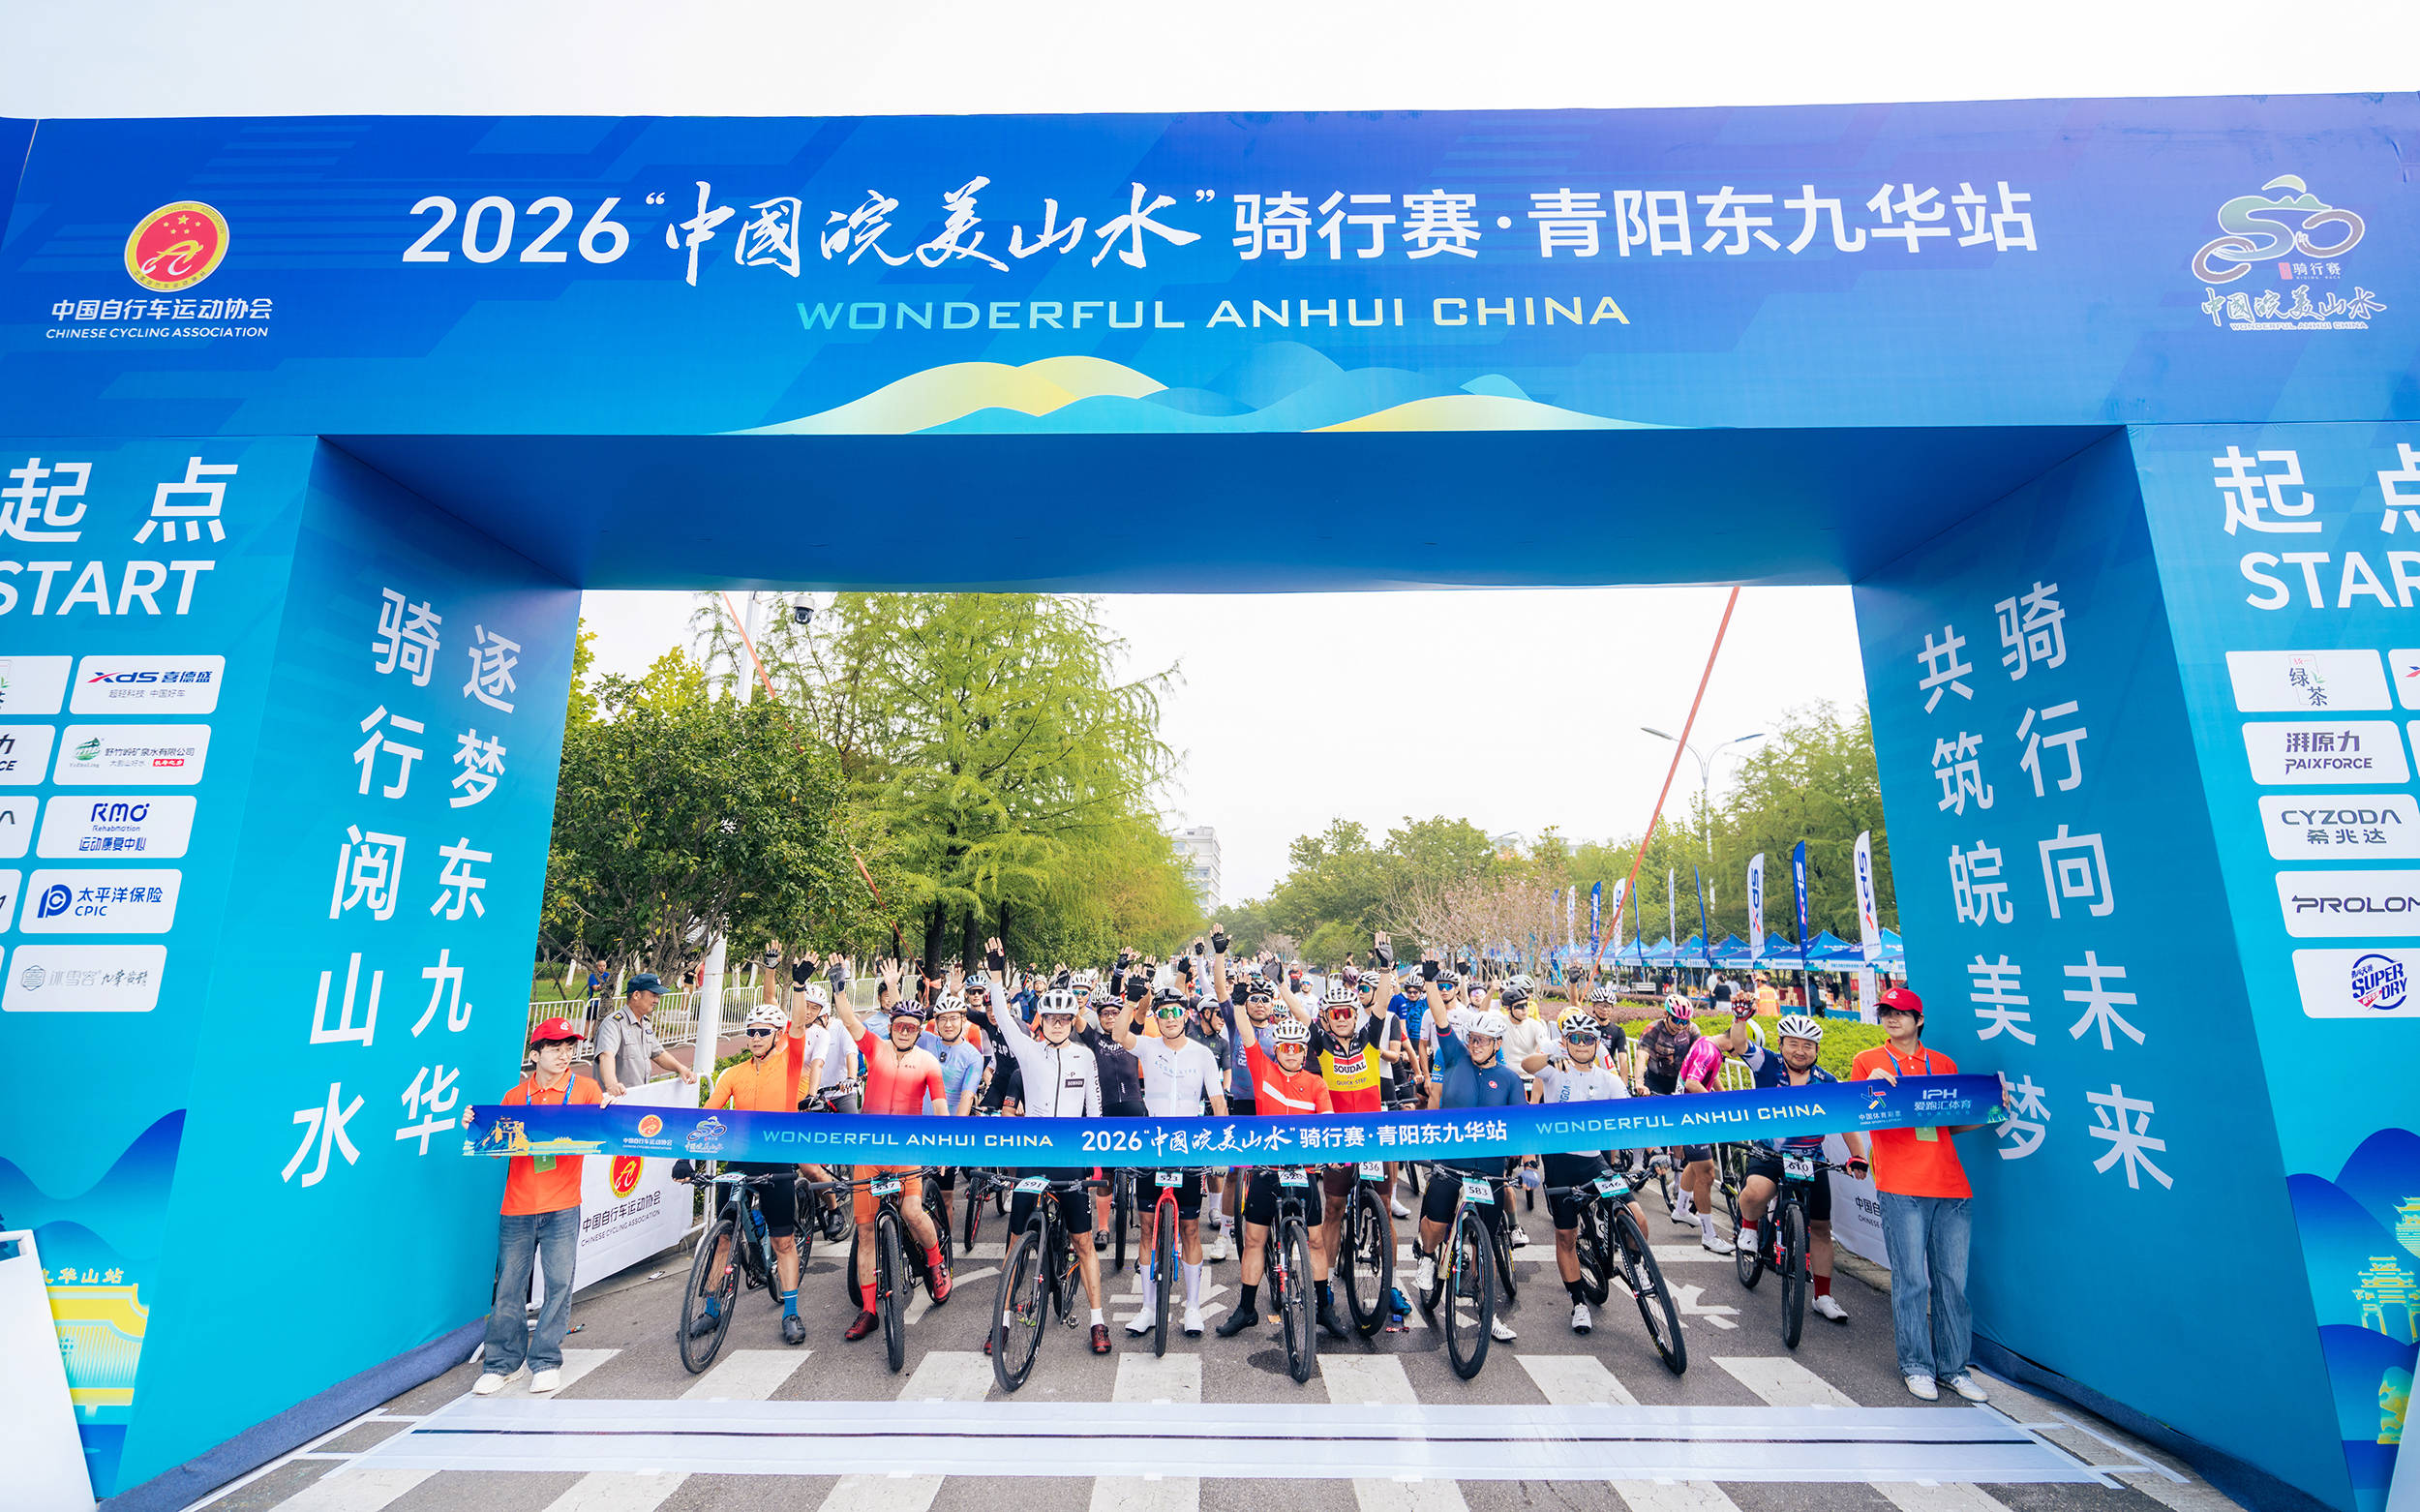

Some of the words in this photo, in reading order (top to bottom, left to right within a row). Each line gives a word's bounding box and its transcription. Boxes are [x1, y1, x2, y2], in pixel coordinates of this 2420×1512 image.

[2292, 262, 2341, 275] 骑行赛
[51, 297, 273, 321] 中国自行车运动协会
[797, 300, 1185, 330] WONDERFUL
[1206, 297, 1403, 327] ANHUI
[1433, 296, 1631, 326] CHINA
[45, 328, 106, 339] CHINESE
[109, 327, 169, 338] CYCLING
[171, 326, 268, 338] ASSOCIATION
[2230, 321, 2296, 331] WONDERFUL
[2298, 321, 2332, 330] ANHUI
[161, 671, 212, 683] 喜德盛
[2289, 667, 2327, 706] 绿茶
[2285, 730, 2360, 752] 湃原力
[2285, 758, 2373, 774] PAIXFORCE
[2281, 809, 2403, 825] CYZODA
[78, 836, 146, 852] 运动康复中心
[2307, 829, 2387, 844] 希兆达
[281, 587, 441, 1189] 骑行阅山水
[395, 623, 521, 1156] 逐梦东九华
[1917, 624, 2050, 1161] 共筑皖美梦
[1994, 581, 2174, 1191] 骑行向未来
[77, 887, 163, 903] 太平洋保险
[76, 905, 107, 917] CPIC
[2352, 963, 2405, 999] SUPER
[2382, 978, 2407, 1000] DRY
[1334, 1062, 1366, 1073] SOUDAL
[1922, 1088, 1957, 1100] IPH
[1914, 1100, 1971, 1111] 爱跑汇体育
[1536, 1115, 1673, 1134] WONDERFUL
[1680, 1109, 1749, 1126] ANHUI
[1758, 1104, 1826, 1120] CHINA
[763, 1131, 898, 1145] WONDERFUL
[906, 1134, 976, 1146] ANHUI
[984, 1134, 1054, 1147] CHINA
[1363, 1162, 1379, 1171] 536
[1468, 1186, 1488, 1195] 583
[1601, 1181, 1621, 1190] 546
[582, 1191, 661, 1232] 中国自行车运动协会
[581, 1231, 605, 1247] CHINESE
[606, 1223, 627, 1236] CYCLING
[628, 1209, 660, 1226] ASSOCIATION
